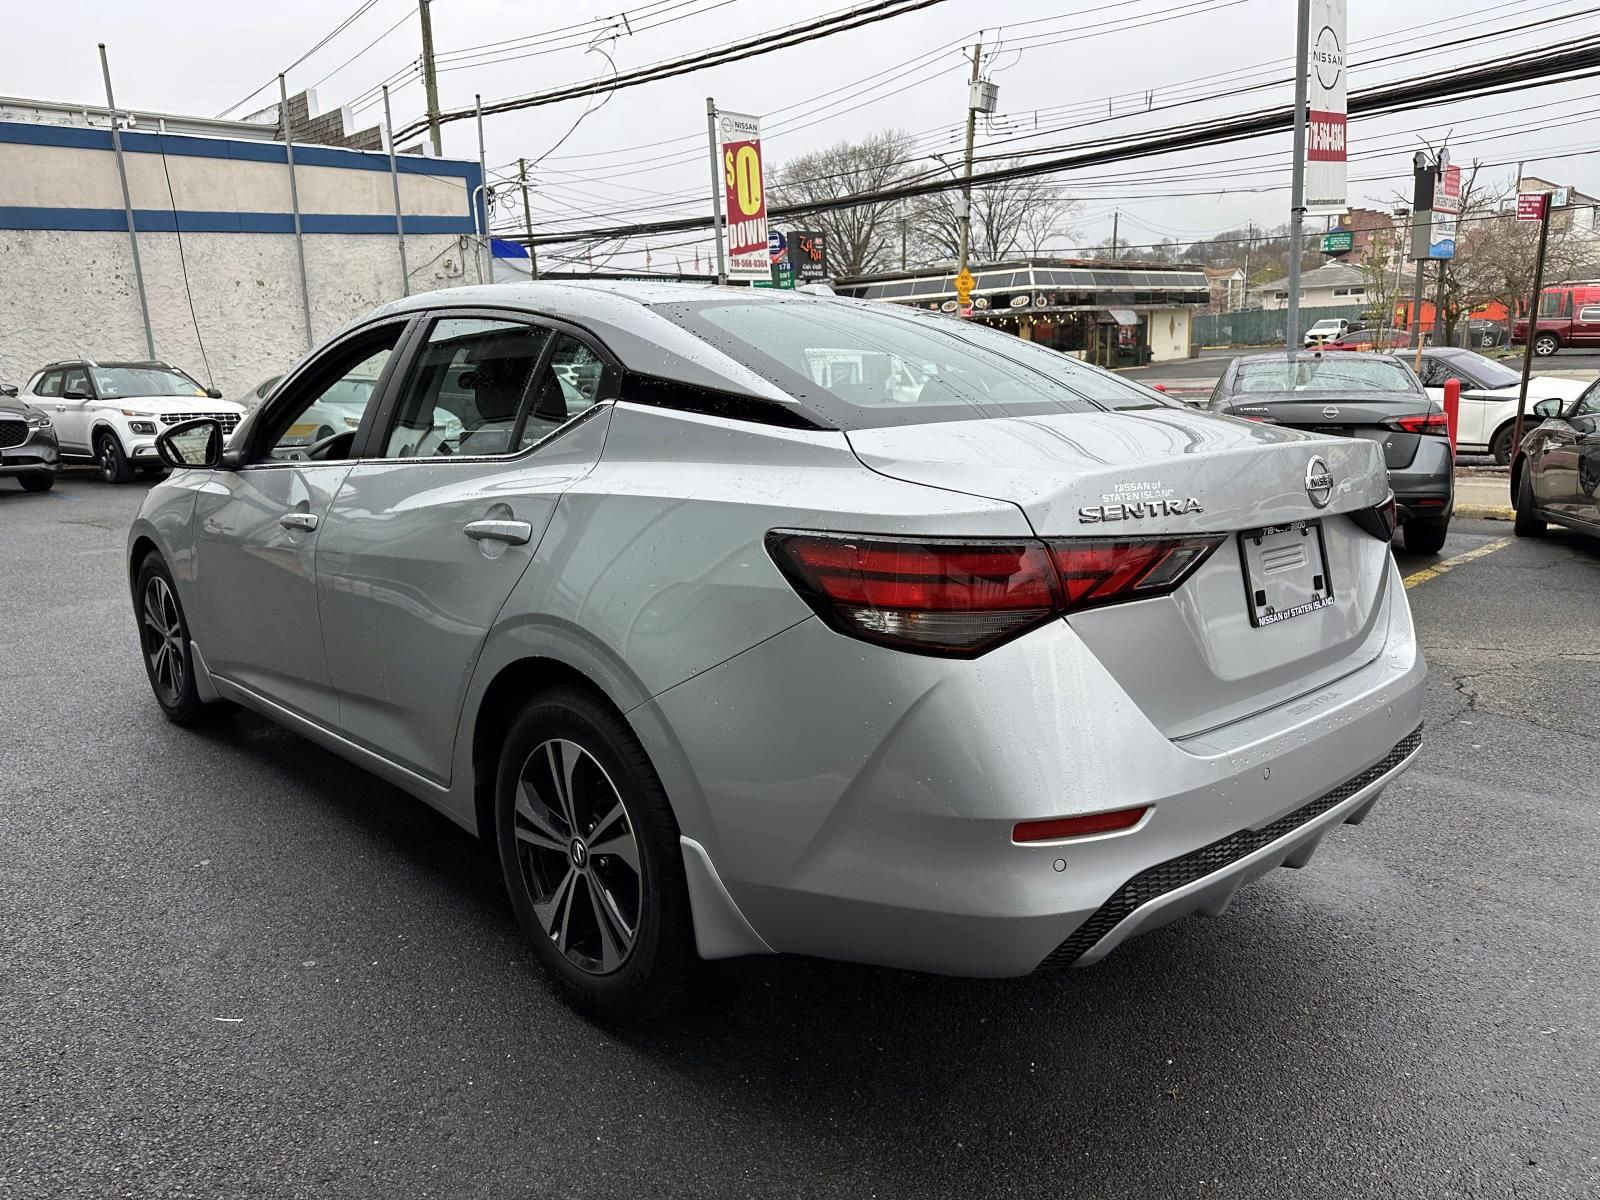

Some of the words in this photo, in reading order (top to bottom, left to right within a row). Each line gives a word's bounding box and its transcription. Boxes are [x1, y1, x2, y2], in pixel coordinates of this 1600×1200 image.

[1313, 50, 1342, 66] NISSAN
[734, 121, 758, 131] NISSAN
[725, 145, 761, 216] $0
[729, 217, 767, 250] DOWN
[730, 258, 768, 268] 718-568-0364
[1114, 482, 1151, 492] NISSAN
[1103, 491, 1140, 503] STATEN
[1140, 489, 1174, 500] ISLAND
[1078, 497, 1204, 524] SENTRA
[1258, 611, 1284, 627] NISSAN
[1290, 604, 1313, 616] STATEN
[1312, 596, 1334, 610] ISLAND
